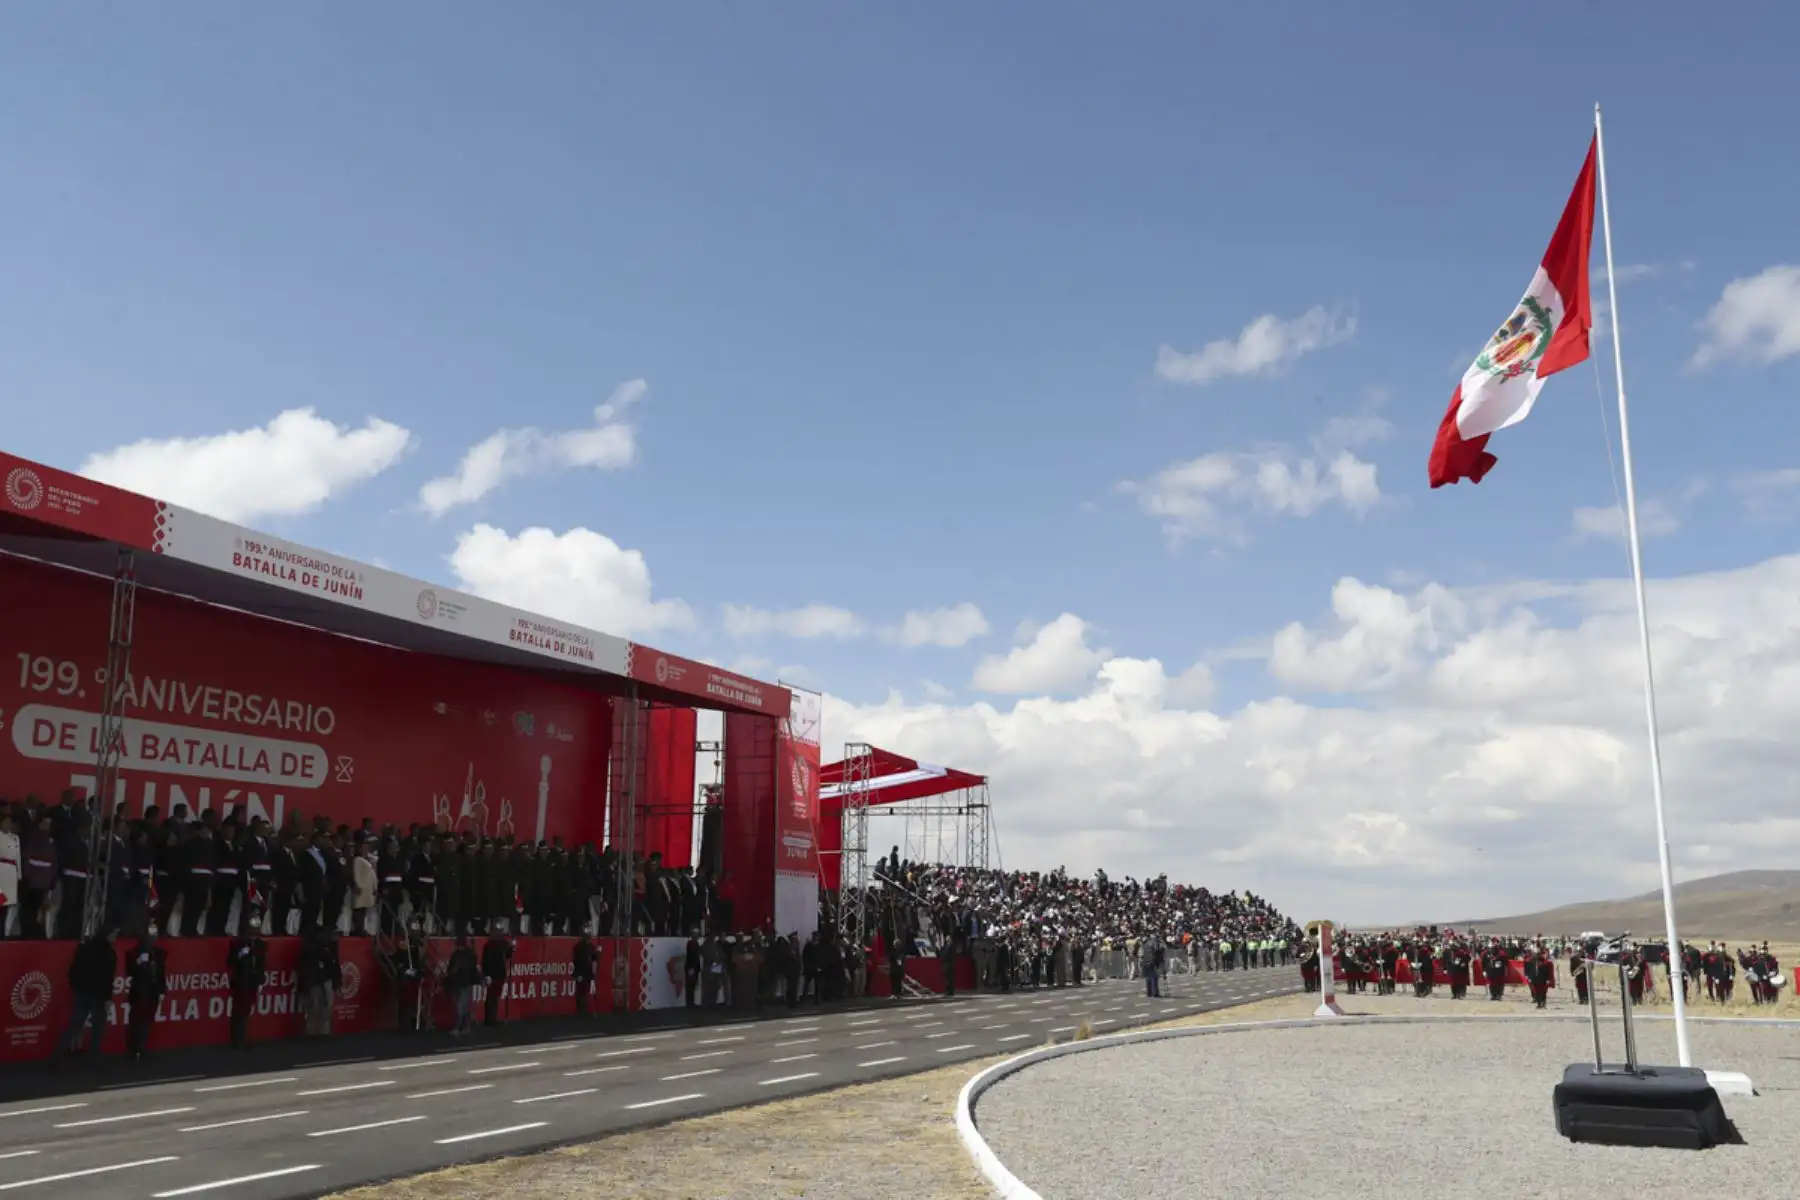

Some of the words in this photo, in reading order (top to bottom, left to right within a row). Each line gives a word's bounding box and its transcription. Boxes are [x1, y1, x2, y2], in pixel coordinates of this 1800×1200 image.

[268, 547, 331, 574] ANIVERSARIO
[232, 551, 297, 583] BATALLA
[301, 571, 320, 588] DE
[323, 578, 363, 601] JUNÍN
[509, 628, 551, 650] BATALLA
[553, 639, 566, 653] DE
[112, 673, 336, 735] ANIVERSARIO
[31, 718, 78, 752] DE
[89, 726, 128, 758] LA
[140, 733, 271, 775] BATALLA
[280, 753, 315, 779] DE
[164, 972, 231, 991] NIVERSA
[541, 980, 557, 998] DE
